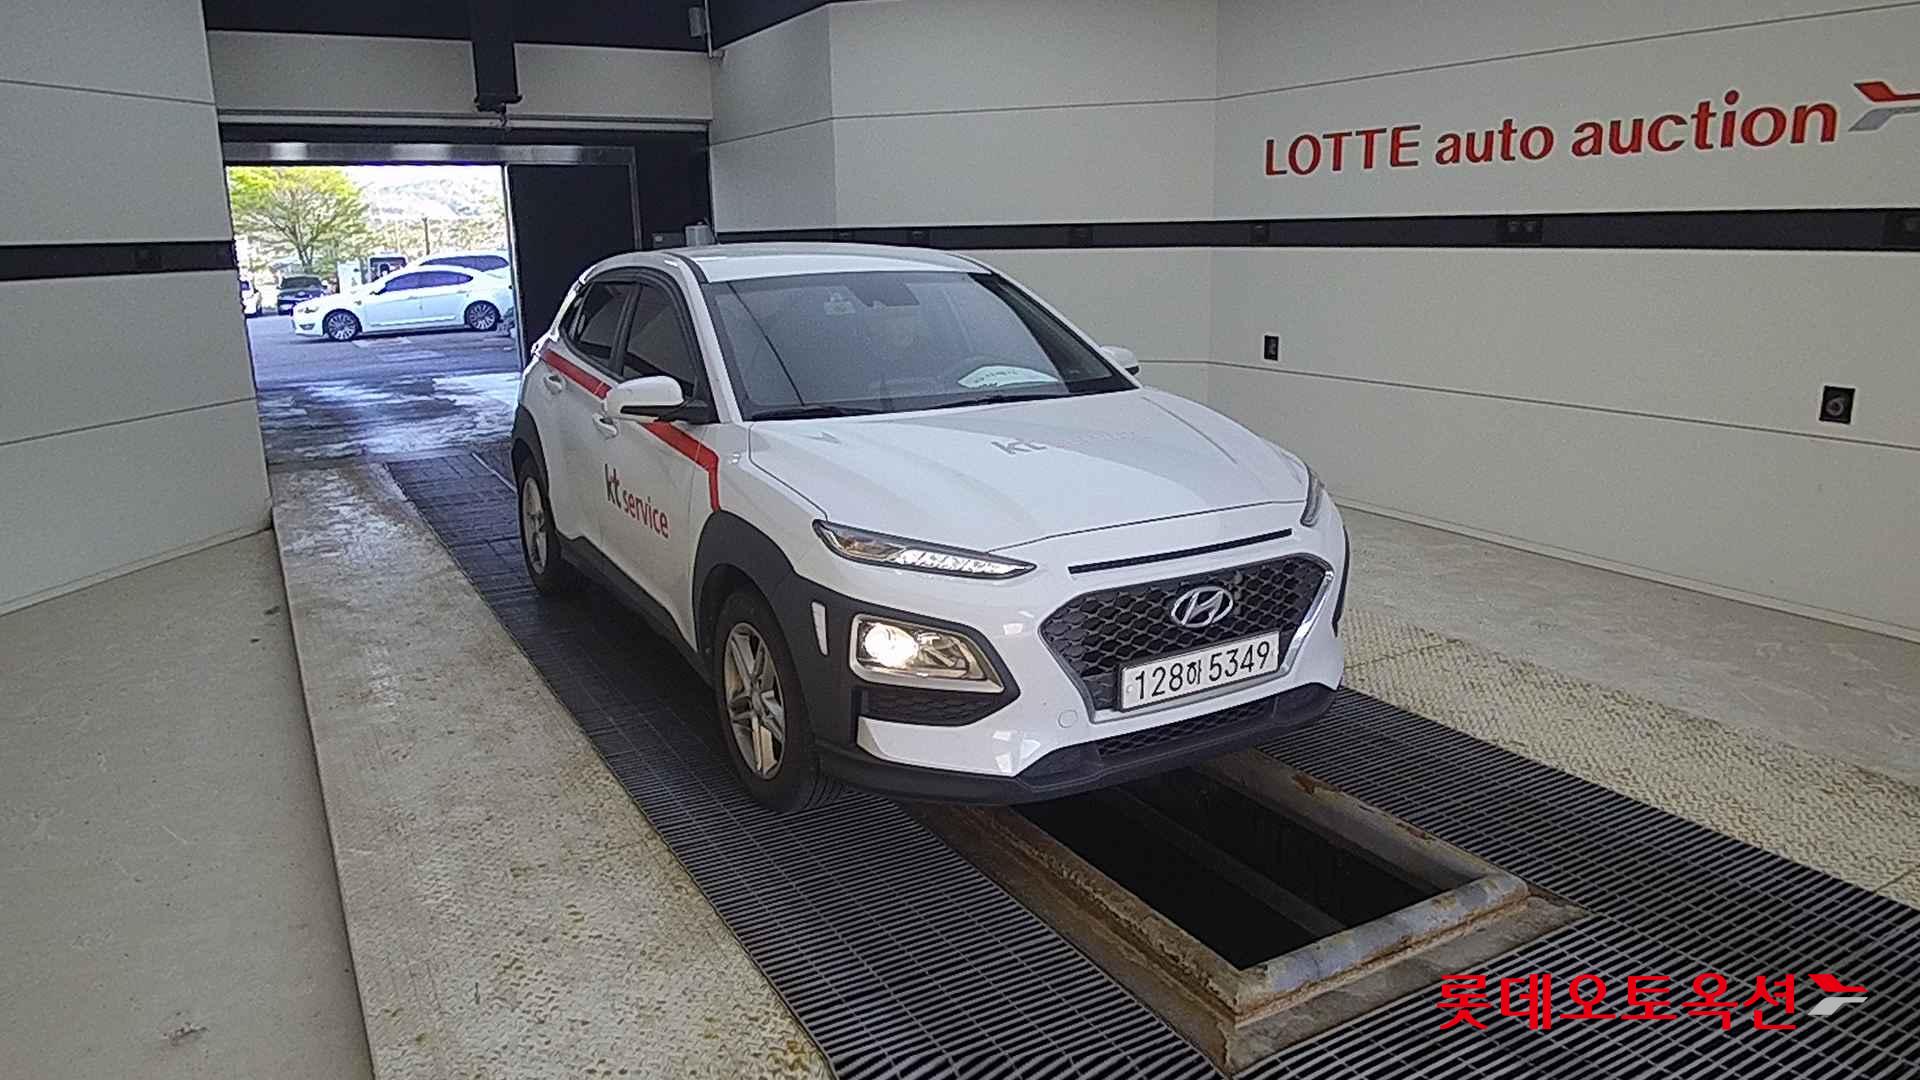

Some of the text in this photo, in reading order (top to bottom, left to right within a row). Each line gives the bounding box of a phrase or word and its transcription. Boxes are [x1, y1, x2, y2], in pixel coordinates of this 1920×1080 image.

[1265, 90, 1839, 176] LOTTE auto auction
[990, 440, 1048, 455] kt
[604, 463, 669, 539] kt service
[1135, 640, 1271, 700] 128하 5349
